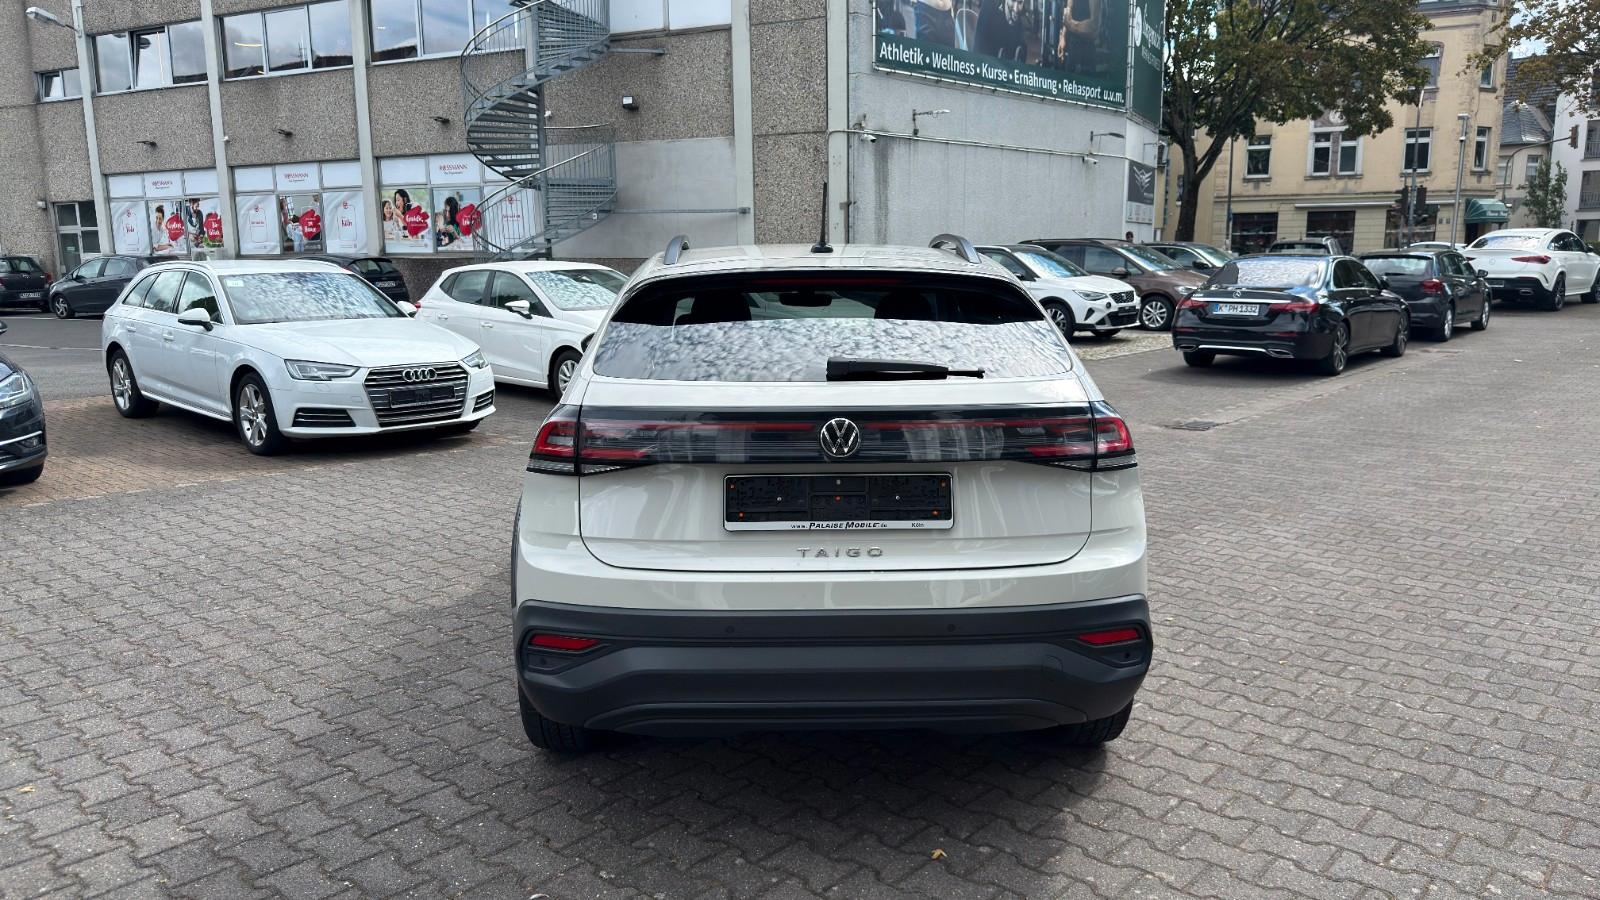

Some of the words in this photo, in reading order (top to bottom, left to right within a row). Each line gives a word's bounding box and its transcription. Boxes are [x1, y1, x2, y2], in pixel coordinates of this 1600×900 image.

[879, 42, 923, 66] Athletik
[932, 54, 975, 76] Wellness
[982, 64, 1008, 82] Kurse
[1014, 70, 1058, 94] Ernährung
[1062, 79, 1101, 99] Rehasport
[797, 546, 883, 558] TAIGO
